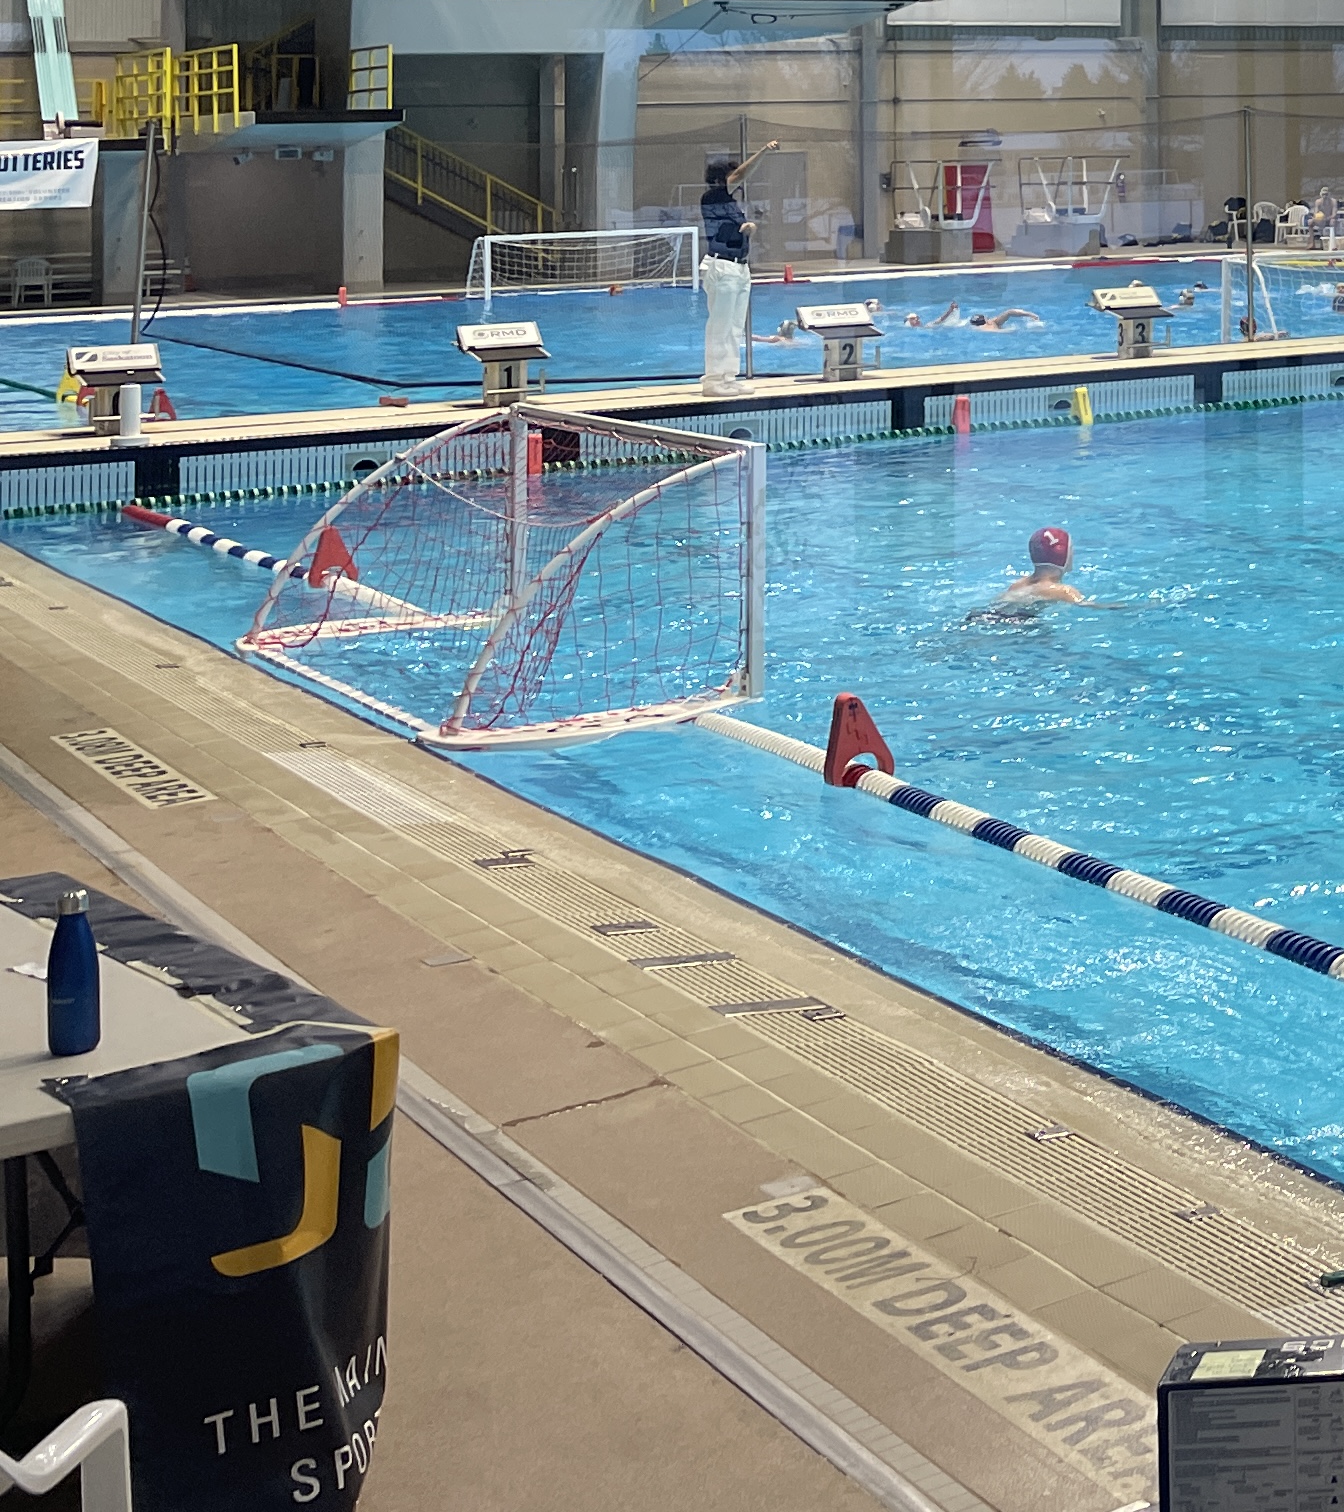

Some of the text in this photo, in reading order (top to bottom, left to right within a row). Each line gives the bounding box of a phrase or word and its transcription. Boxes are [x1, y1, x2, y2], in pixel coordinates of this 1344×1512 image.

[503, 365, 513, 389] 1
[842, 343, 854, 365] 2
[1044, 530, 1059, 545] 1
[94, 753, 206, 808] DEEP AREA
[742, 1194, 1060, 1374] 3.00M DEEP
[203, 1385, 324, 1456] THE
[290, 1407, 382, 1504] SPOR
